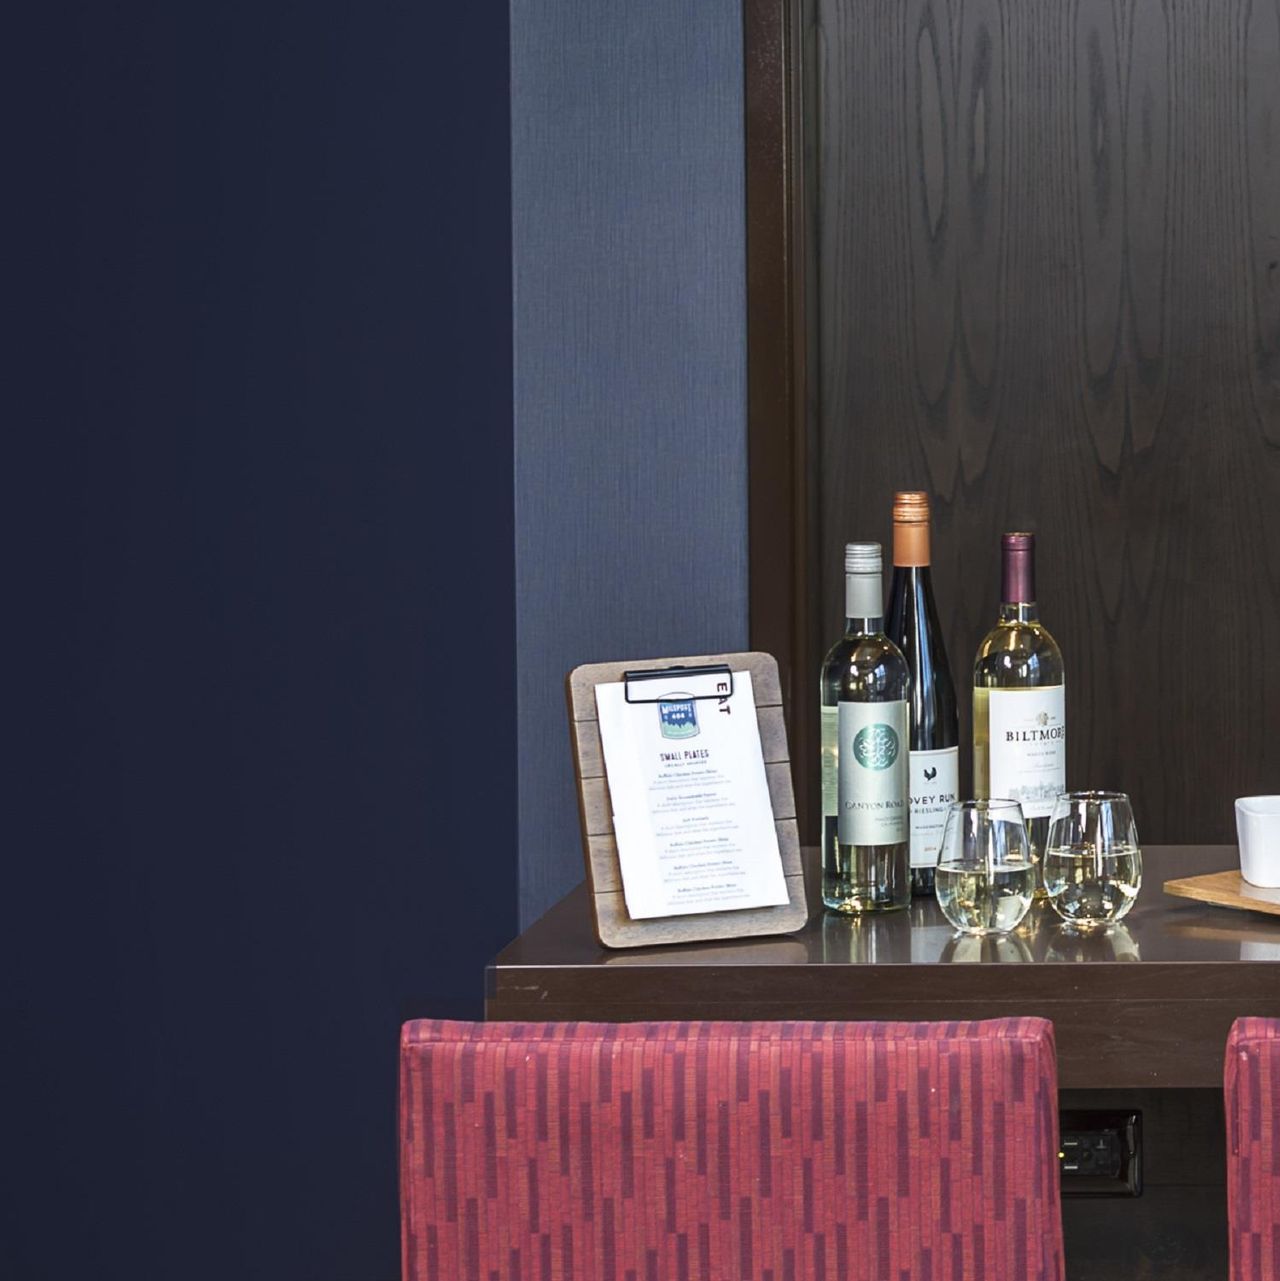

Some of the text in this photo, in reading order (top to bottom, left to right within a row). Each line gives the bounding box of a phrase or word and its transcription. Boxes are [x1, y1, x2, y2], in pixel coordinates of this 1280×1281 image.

[659, 749, 710, 762] SMALL PLATES
[845, 801, 885, 810] CANYON
